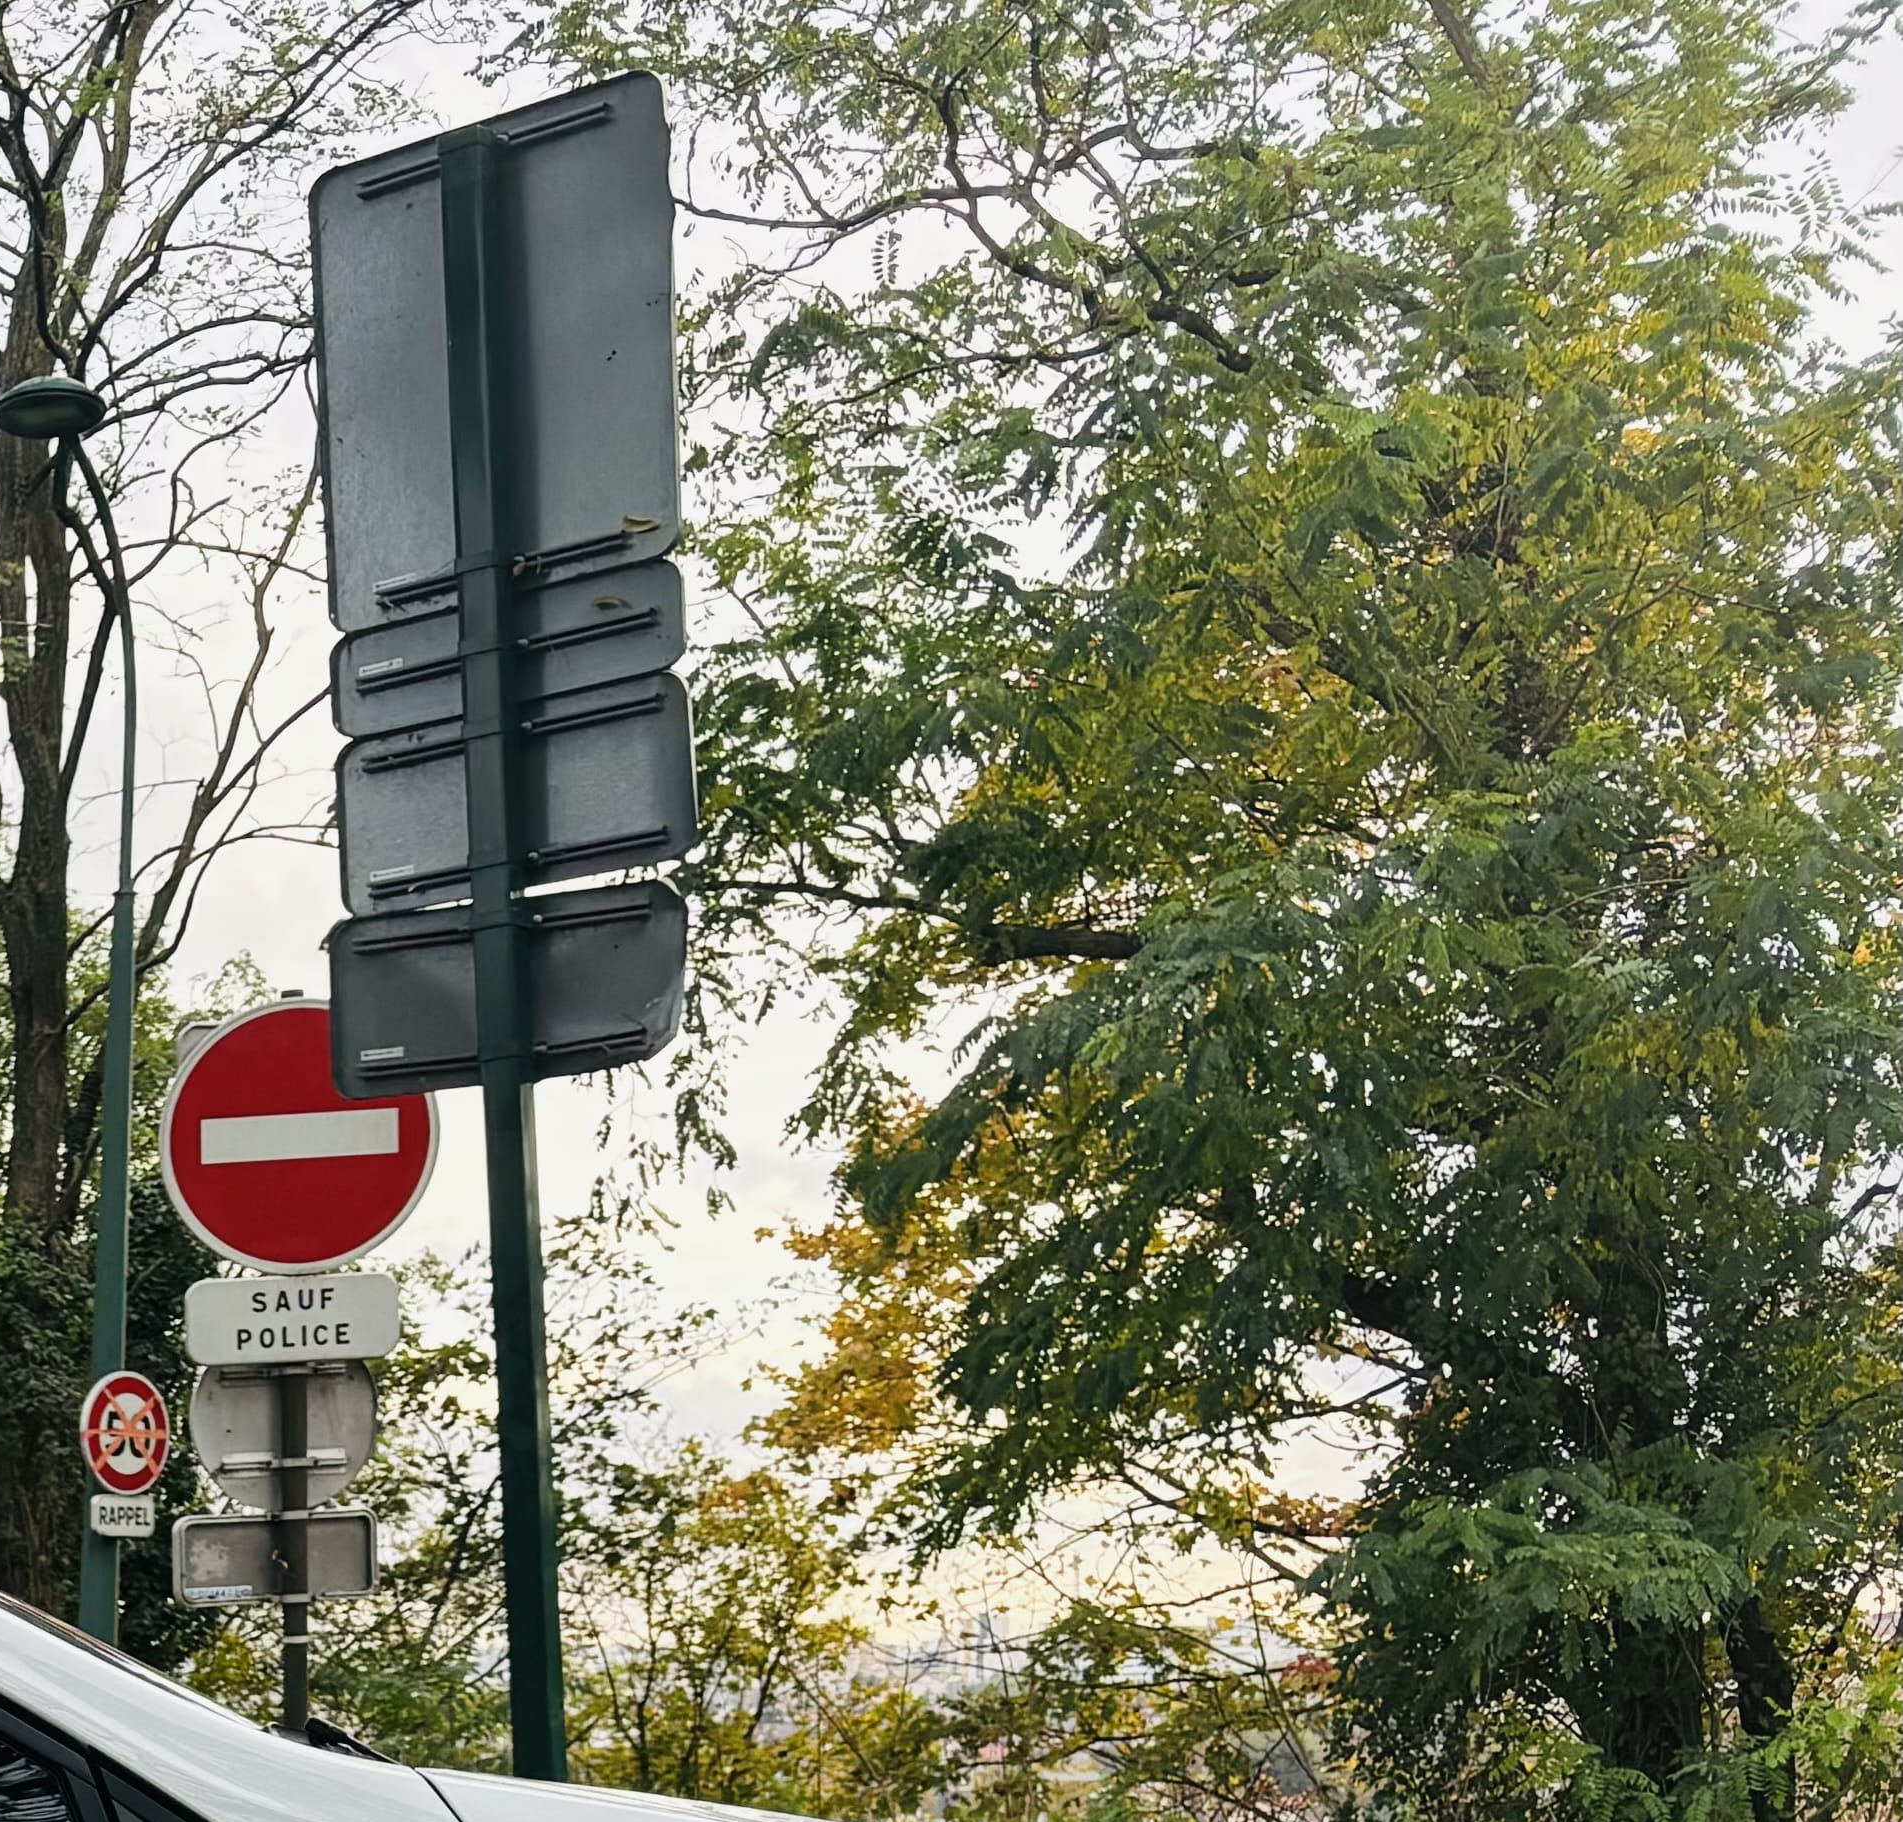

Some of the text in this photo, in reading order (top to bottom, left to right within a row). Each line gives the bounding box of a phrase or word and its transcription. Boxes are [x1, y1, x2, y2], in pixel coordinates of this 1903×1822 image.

[251, 1287, 335, 1313] SAUF
[236, 1322, 351, 1350] POLICE
[98, 1506, 151, 1526] RAPPEL
